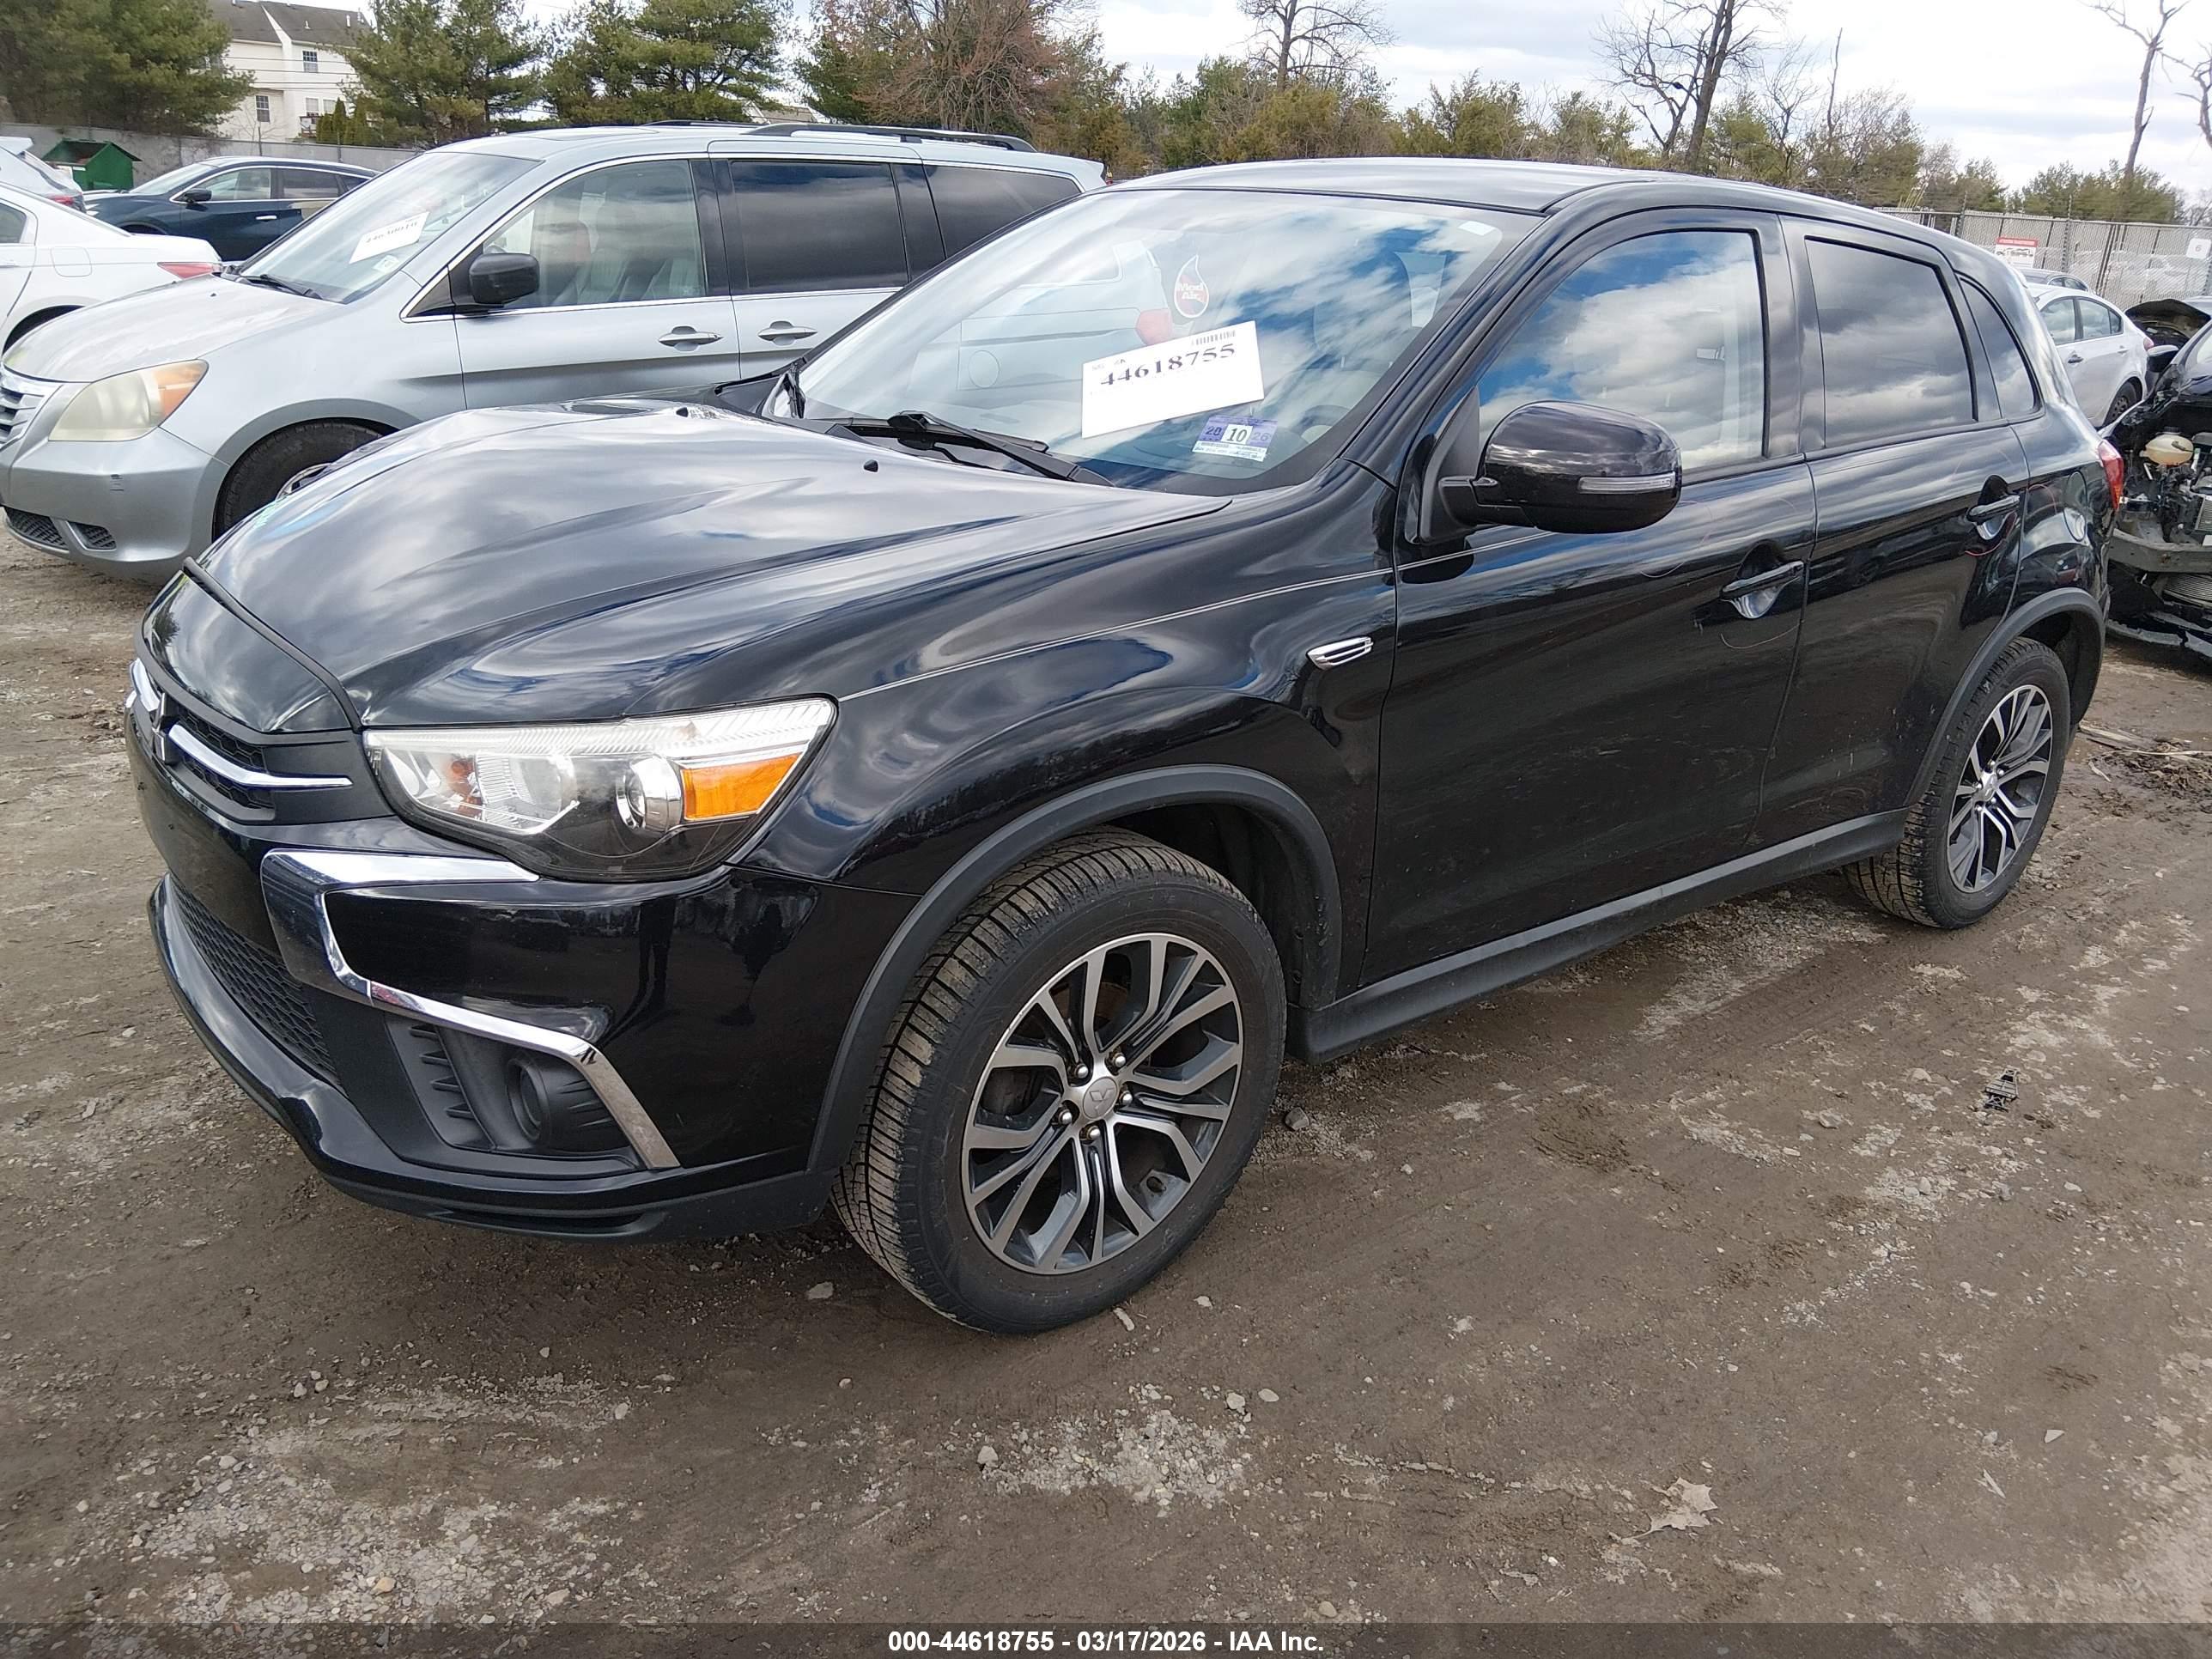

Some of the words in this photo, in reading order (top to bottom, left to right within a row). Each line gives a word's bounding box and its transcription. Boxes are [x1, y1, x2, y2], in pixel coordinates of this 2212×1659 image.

[1100, 343, 1235, 386] 44618755
[1205, 425, 1223, 436] 20
[1226, 428, 1248, 443] 10
[1251, 432, 1271, 442] 26
